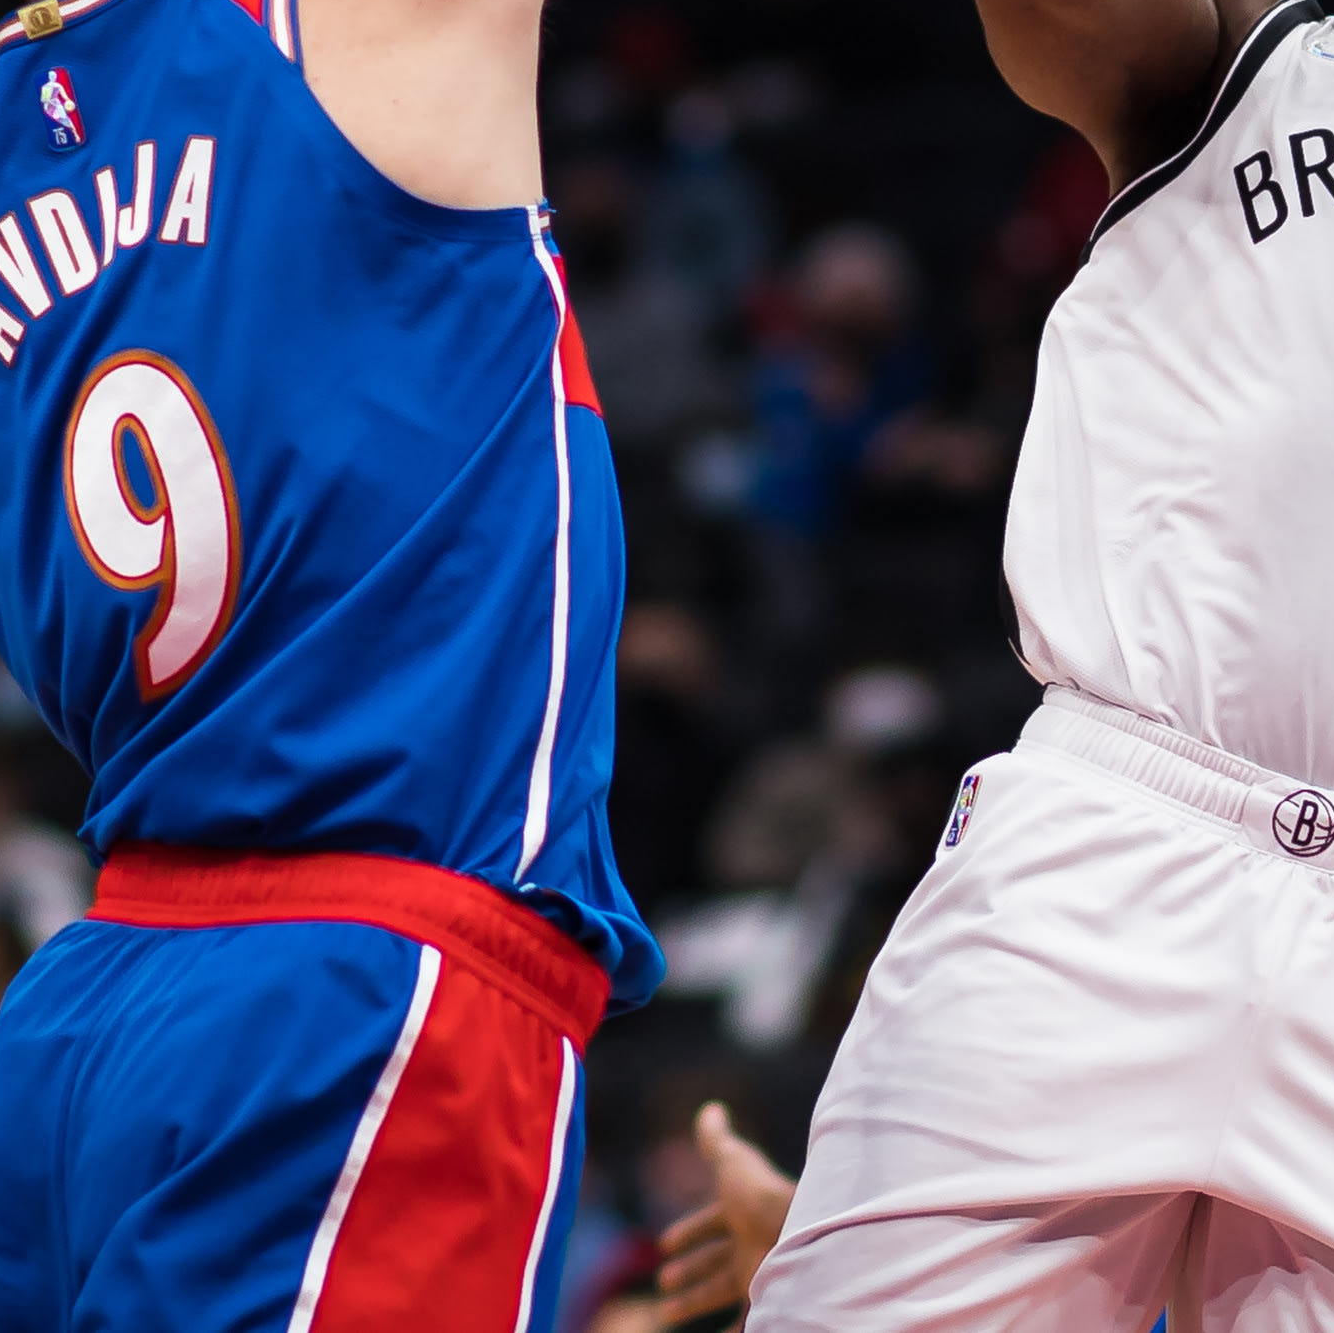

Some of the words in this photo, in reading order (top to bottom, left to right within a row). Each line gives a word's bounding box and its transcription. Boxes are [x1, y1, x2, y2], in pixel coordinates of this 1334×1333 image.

[52, 127, 68, 146] 75
[63, 347, 244, 705] 9
[1291, 799, 1320, 847] B
